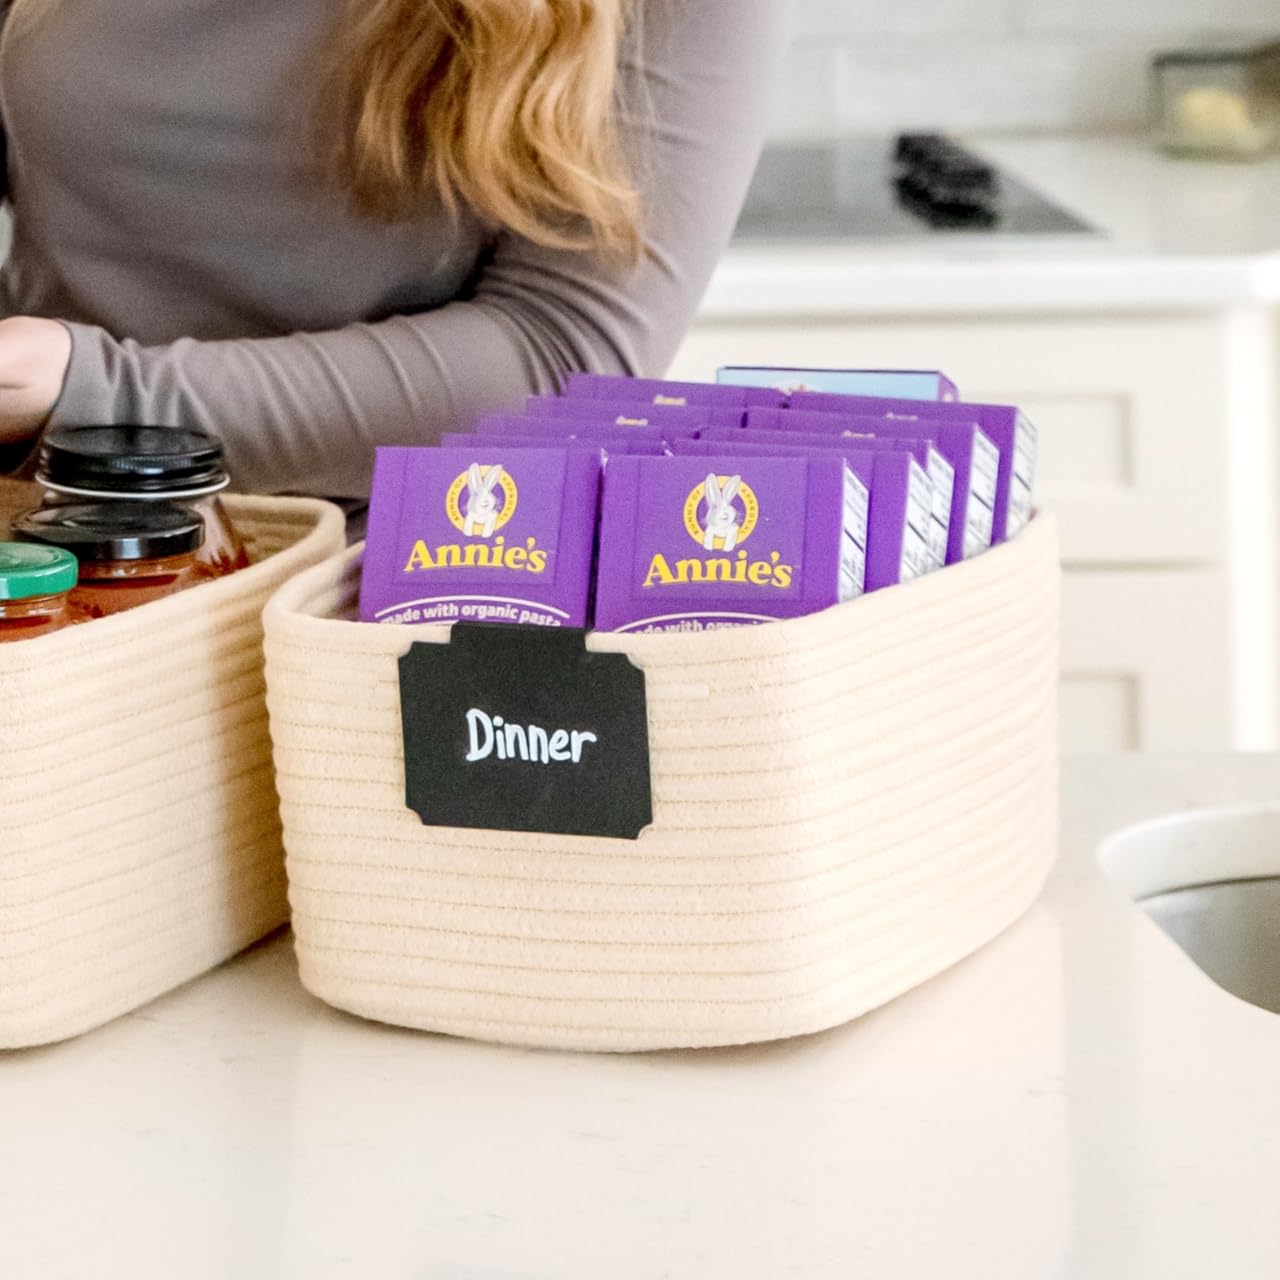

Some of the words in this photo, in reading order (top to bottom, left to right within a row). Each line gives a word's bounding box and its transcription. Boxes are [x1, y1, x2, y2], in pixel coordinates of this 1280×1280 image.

[403, 535, 548, 575] Annie's
[642, 550, 793, 589] Annie's
[423, 602, 458, 619] with
[462, 603, 518, 620] organic
[465, 708, 597, 764] Dinner
